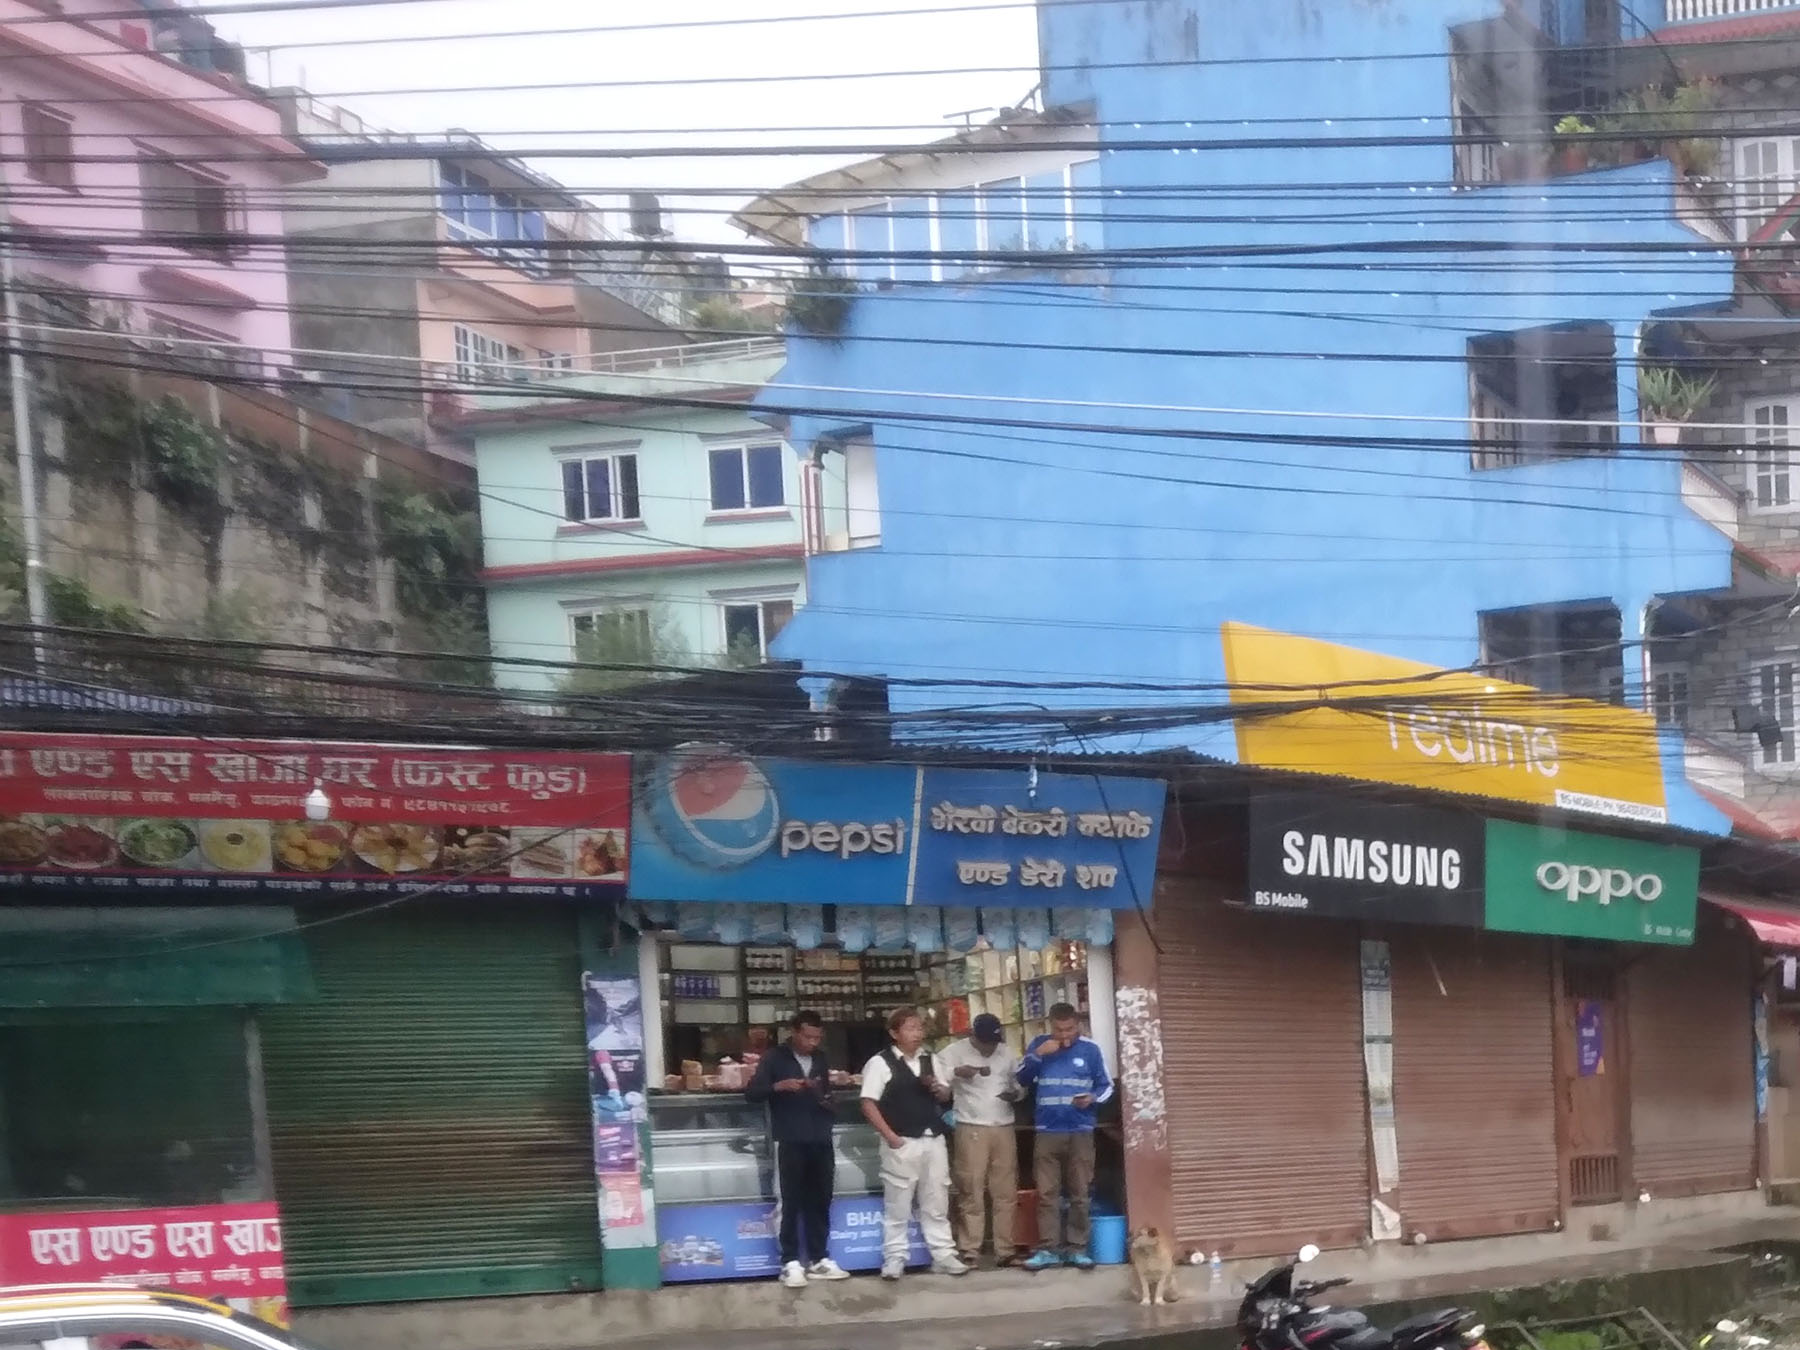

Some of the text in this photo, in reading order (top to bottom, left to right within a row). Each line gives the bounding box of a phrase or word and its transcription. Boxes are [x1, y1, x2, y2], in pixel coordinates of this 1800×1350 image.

[1386, 701, 1561, 778] realme
[130, 750, 193, 783] एस
[782, 818, 904, 859] pepsi
[1282, 830, 1461, 890] SAMSUNG
[1255, 891, 1309, 909] BS Mobile
[1536, 861, 1663, 905] oppo
[29, 1226, 81, 1265] एस
[88, 1224, 157, 1262] एण्ड
[164, 1221, 215, 1258] एस
